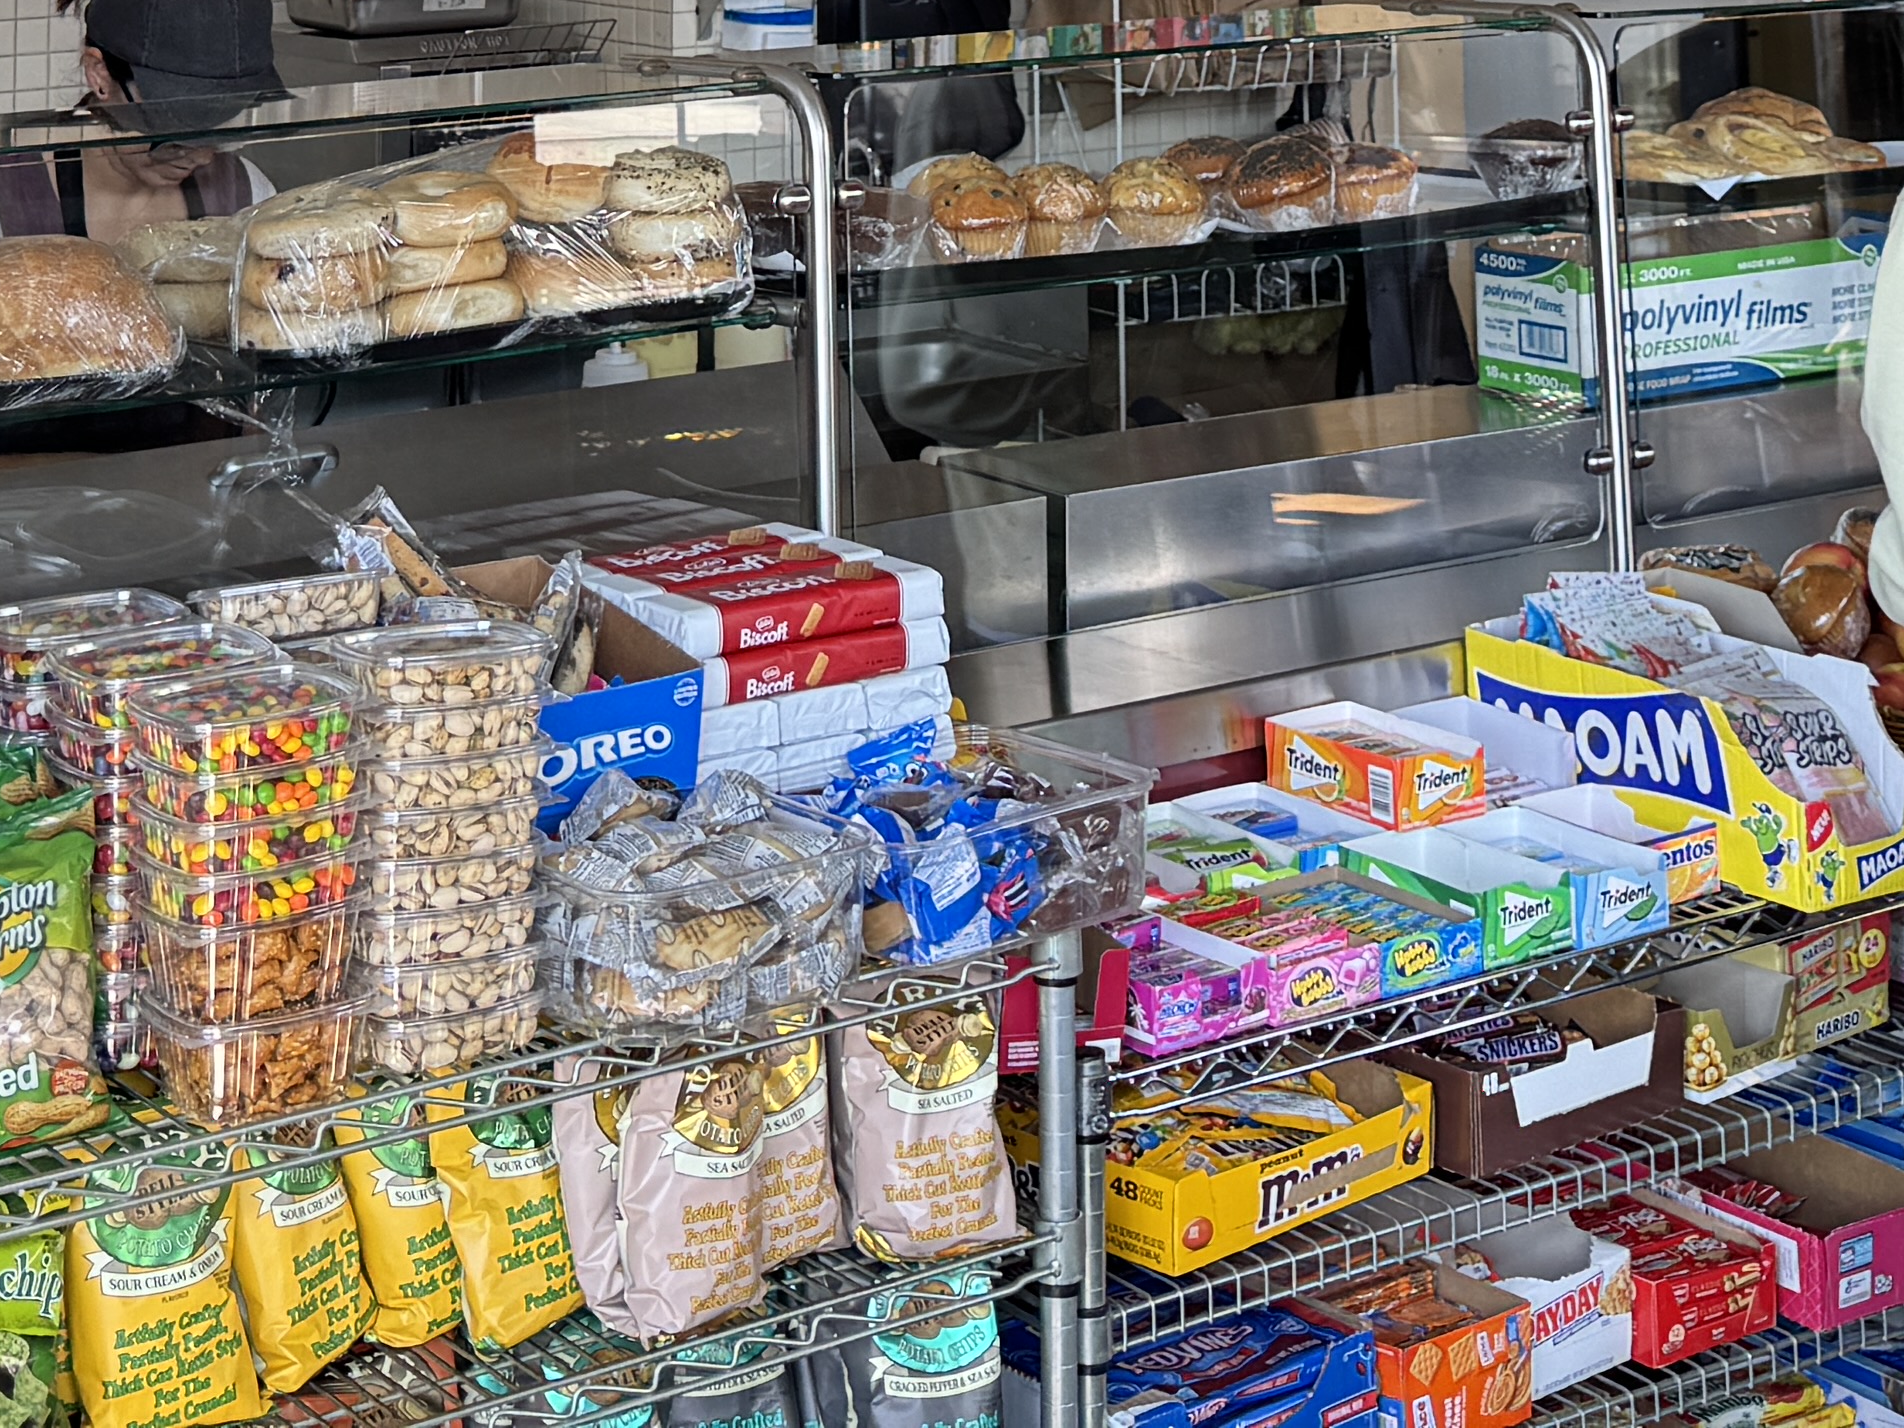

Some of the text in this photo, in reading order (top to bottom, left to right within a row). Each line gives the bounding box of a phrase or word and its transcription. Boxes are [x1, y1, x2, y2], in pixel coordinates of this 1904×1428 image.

[1479, 252, 1517, 271] 4500
[1624, 289, 1809, 335] polyvinyl films
[739, 620, 789, 649] Biscoff
[746, 671, 794, 698] Biscoff
[539, 724, 672, 788] OREO
[1286, 745, 1340, 781] Trident
[1415, 767, 1467, 792] Trident
[1600, 881, 1652, 906] Trident
[1500, 898, 1551, 927] Trident
[1815, 1010, 1860, 1042] HARIBO
[1477, 1032, 1560, 1062] SNICKERS
[918, 1088, 973, 1109] SEA SALTED
[1109, 1176, 1139, 1199] 48
[109, 1275, 141, 1291] SOUR
[145, 1269, 188, 1288] CREAM
[1532, 1272, 1603, 1343] AYDAY
